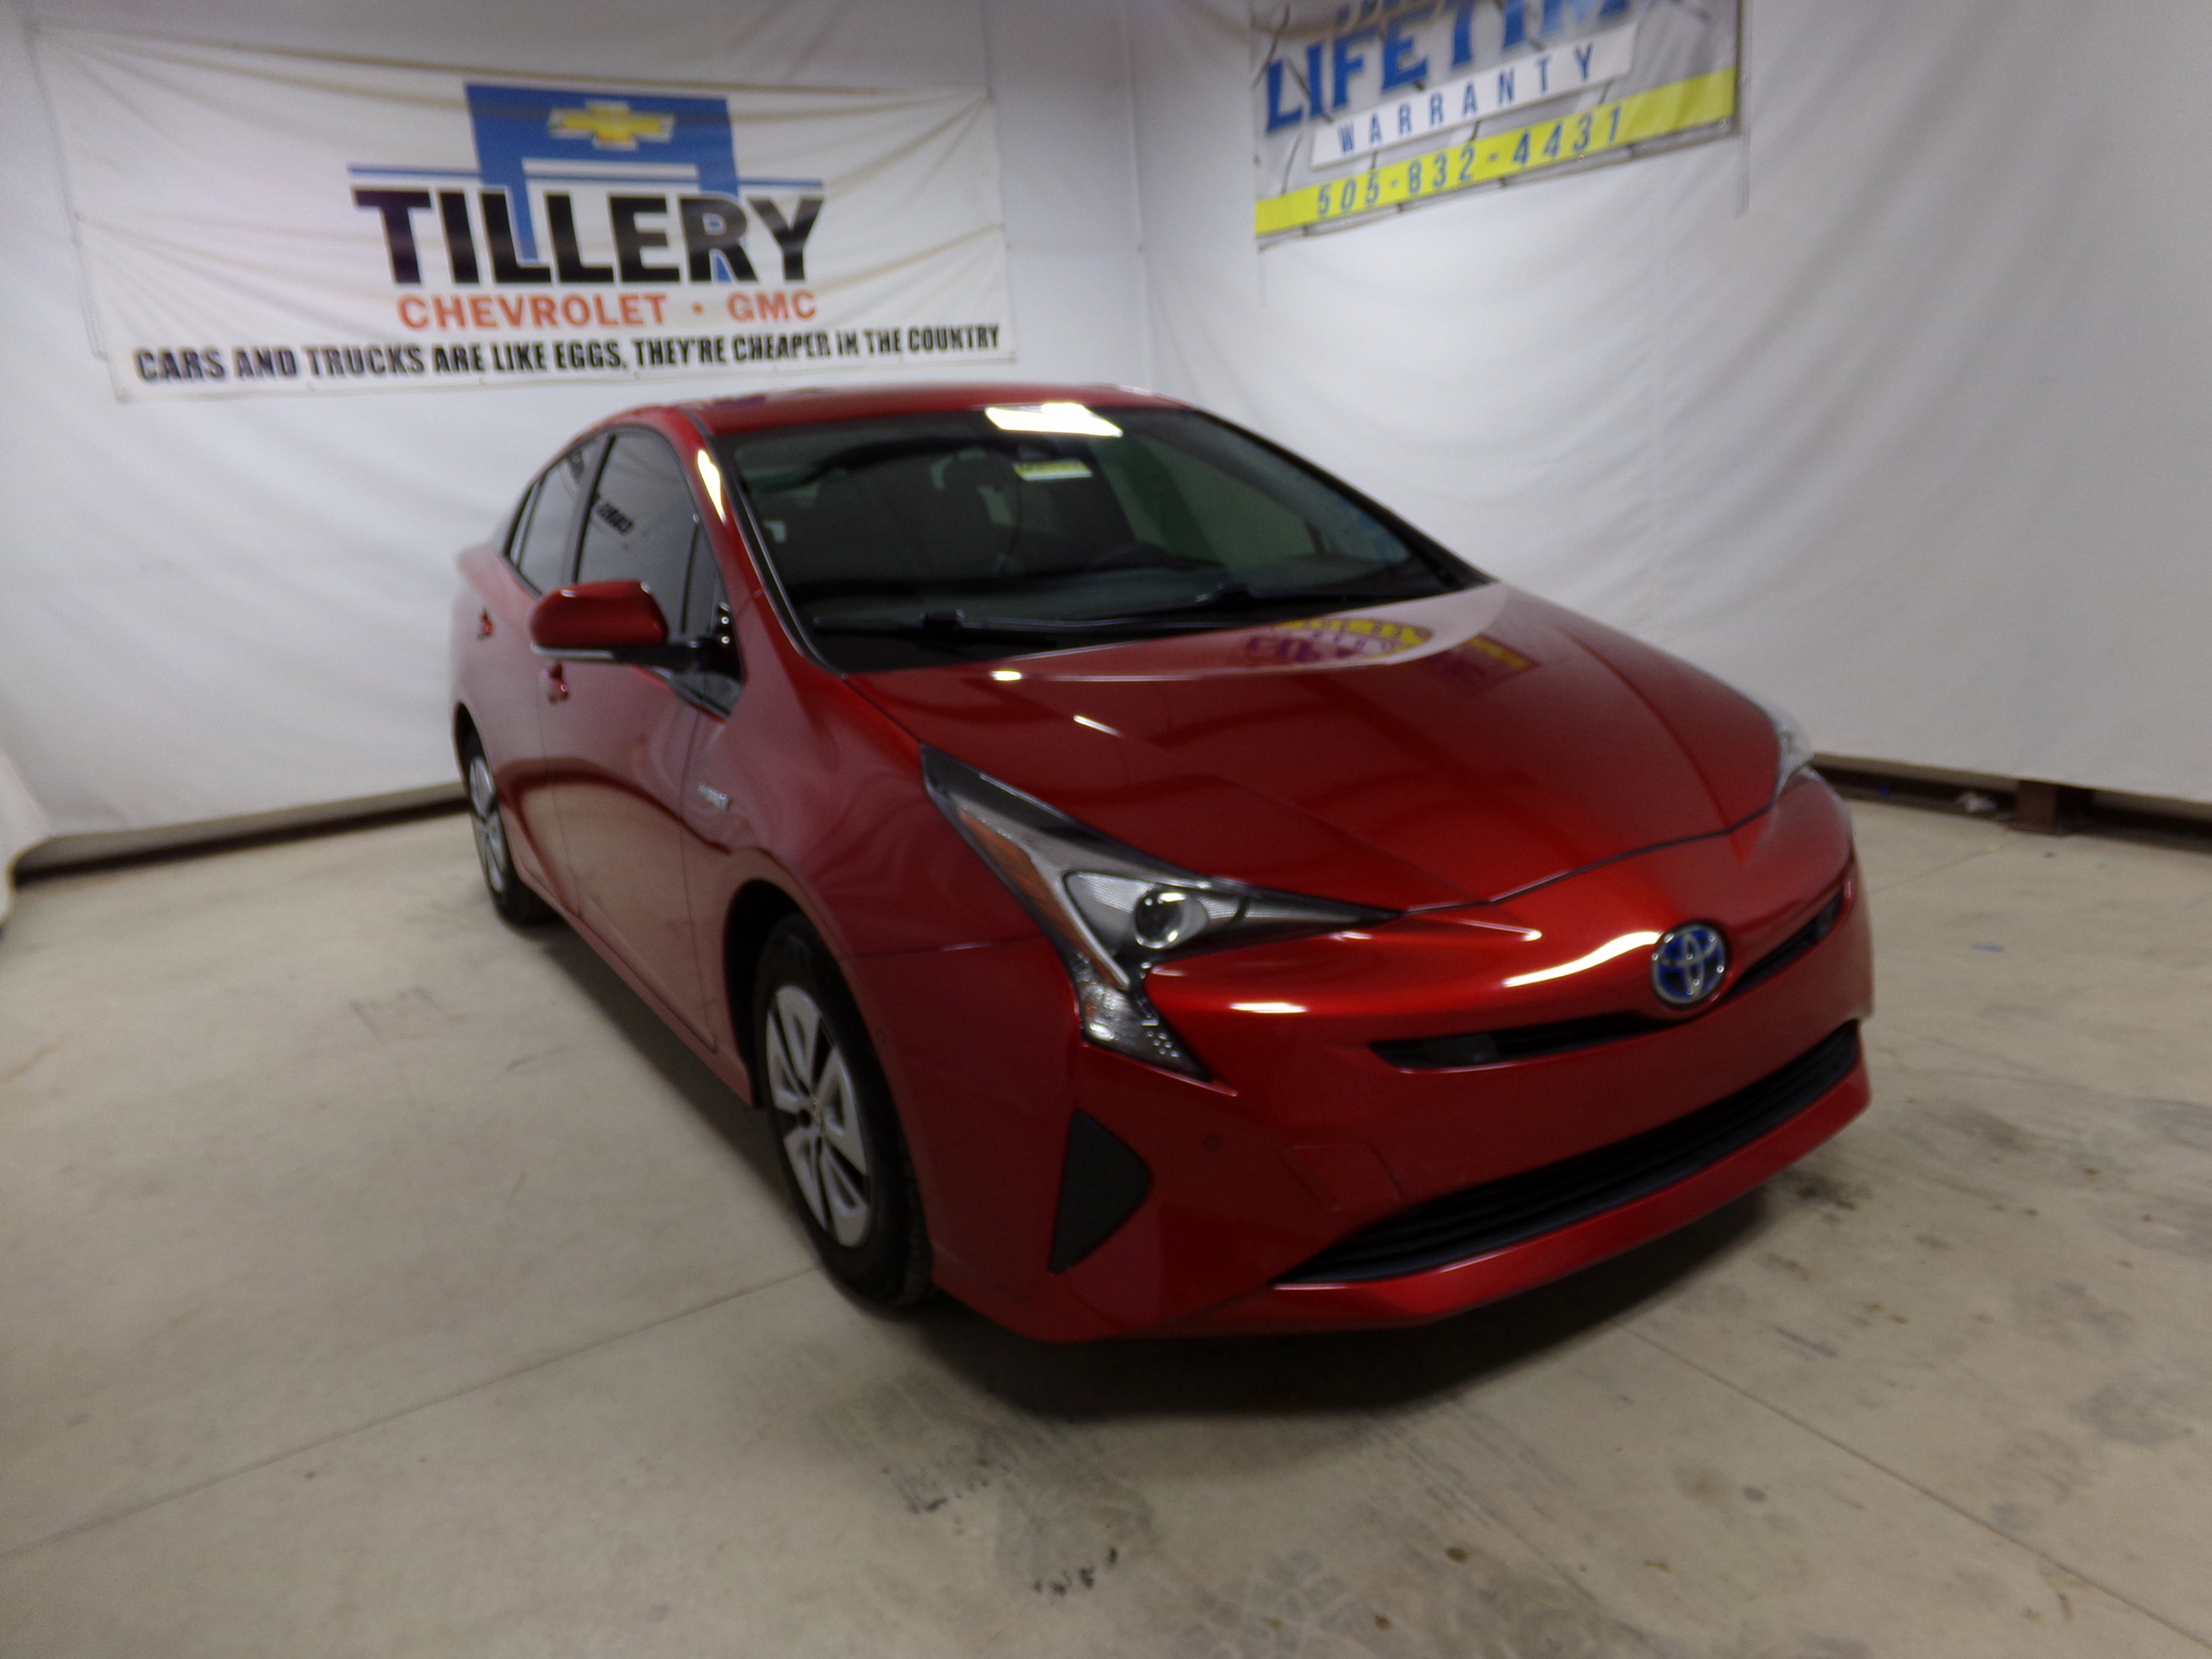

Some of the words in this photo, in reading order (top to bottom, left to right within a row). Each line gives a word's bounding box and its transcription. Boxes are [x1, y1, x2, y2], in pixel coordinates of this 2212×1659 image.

[1337, 43, 1594, 153] WARRANTY
[1317, 104, 1622, 218] 505-832-4431
[354, 188, 825, 285] TILLERY
[135, 347, 226, 382] CARS
[234, 346, 297, 378] AND
[301, 344, 425, 377] TRUCKS
[434, 343, 485, 373] ARE
[491, 341, 547, 372] LIKE
[553, 339, 627, 370] EGGS,
[632, 336, 725, 367] THEY'RE
[732, 332, 831, 362] CHEAPER
[836, 330, 860, 357] IN
[865, 327, 902, 354] THE
[908, 323, 1000, 353] COUNTRY
[397, 291, 669, 331] CHEVROLET
[725, 290, 818, 323] GMC
